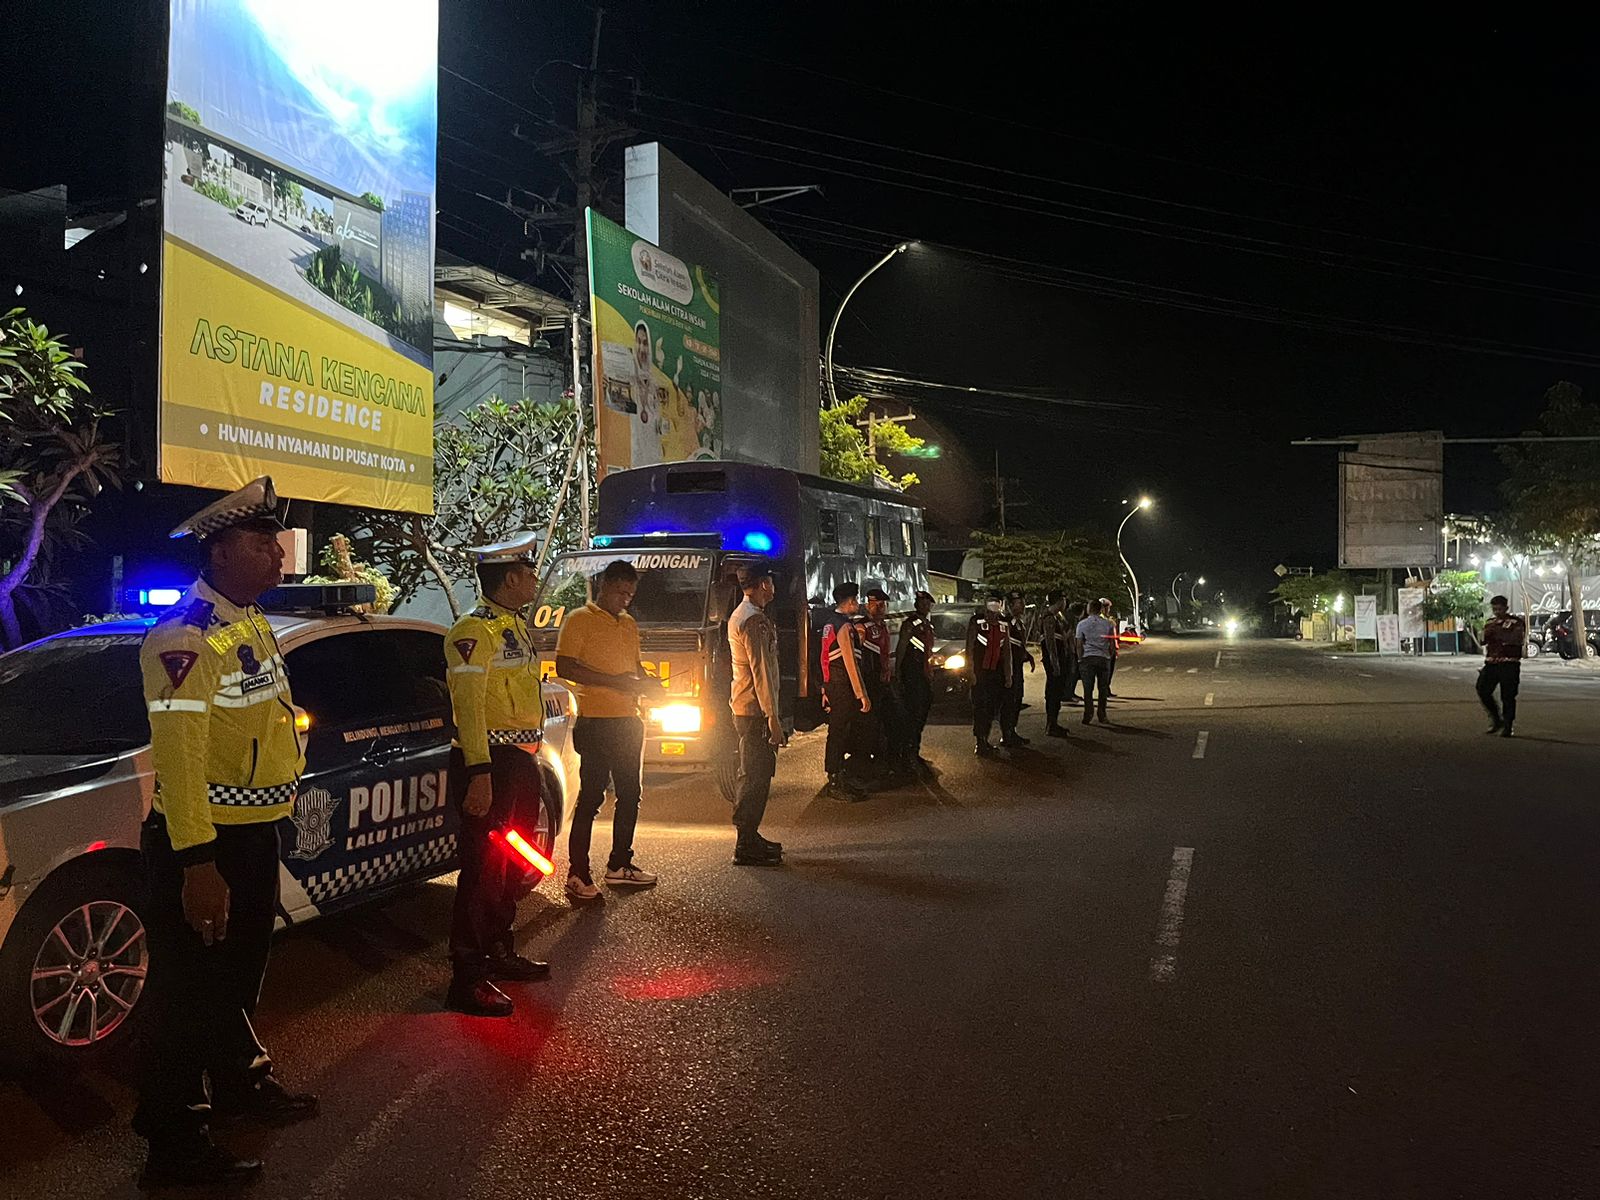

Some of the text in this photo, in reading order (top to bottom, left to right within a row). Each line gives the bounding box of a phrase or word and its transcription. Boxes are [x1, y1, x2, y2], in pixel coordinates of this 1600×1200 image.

[617, 282, 652, 306] SEKOLAH
[652, 297, 670, 314] ALAM
[671, 305, 688, 322] CITRA
[190, 318, 426, 417] ASTANA KENCANA
[259, 381, 383, 432] RESIDENCE
[218, 423, 407, 473] HUNIAN NYAMAN DI PUSAT KOTA
[631, 555, 701, 569] AMONGAN
[534, 604, 565, 628] 01
[349, 770, 447, 829] POLISI
[346, 815, 444, 851] LALU LINTAS
